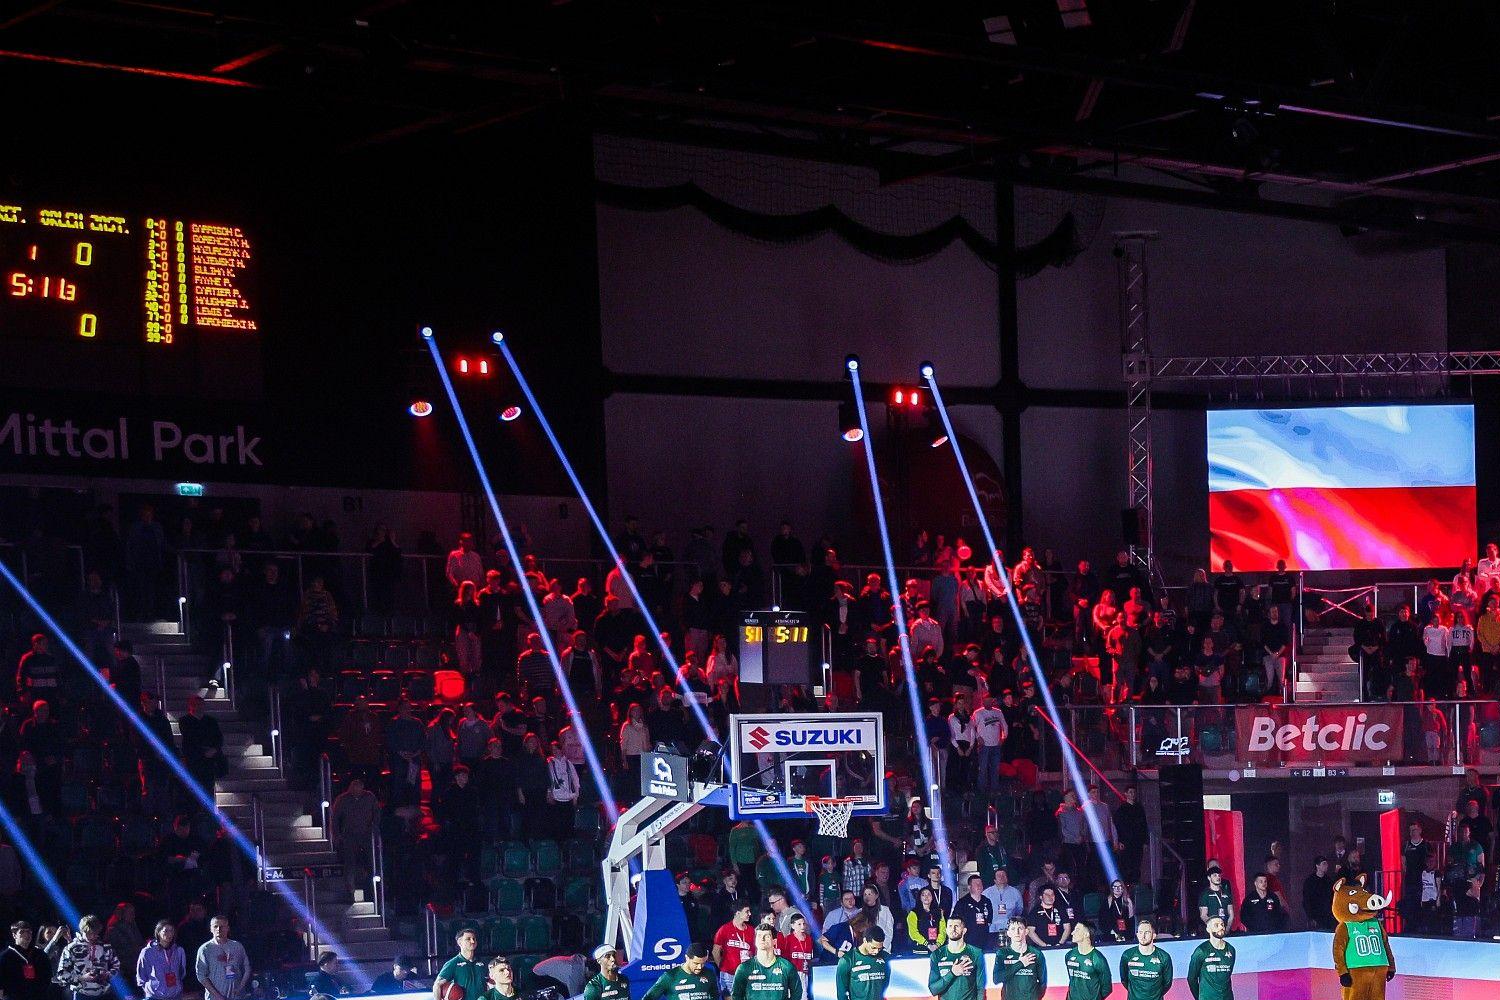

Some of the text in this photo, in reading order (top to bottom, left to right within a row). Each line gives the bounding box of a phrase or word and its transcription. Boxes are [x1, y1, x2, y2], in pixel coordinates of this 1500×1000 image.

[76, 242, 93, 267] 0
[80, 313, 98, 338] 0
[153, 420, 264, 466] Park
[775, 729, 862, 746] SUZUKI
[1248, 713, 1391, 751] Betclic
[1355, 934, 1382, 957] 00
